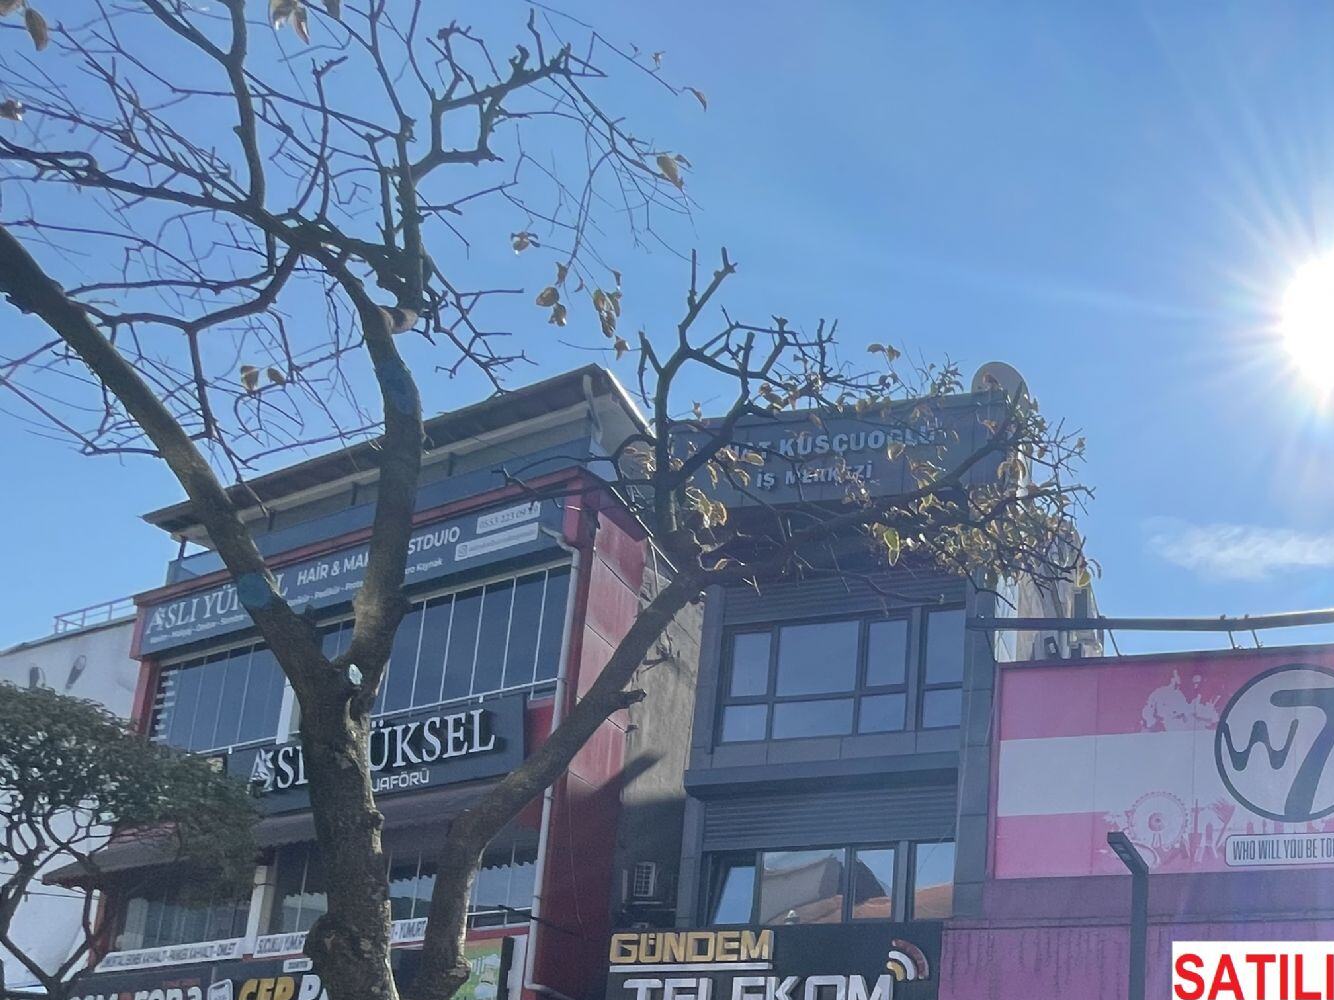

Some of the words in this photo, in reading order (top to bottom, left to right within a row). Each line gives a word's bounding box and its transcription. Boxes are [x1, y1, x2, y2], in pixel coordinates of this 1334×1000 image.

[368, 708, 496, 772] ÜKSEL
[1233, 839, 1256, 861] WHO
[1258, 838, 1282, 860] WILL
[1284, 838, 1303, 860] YOU
[1306, 838, 1318, 859] BE
[609, 929, 775, 964] GÜNDEM
